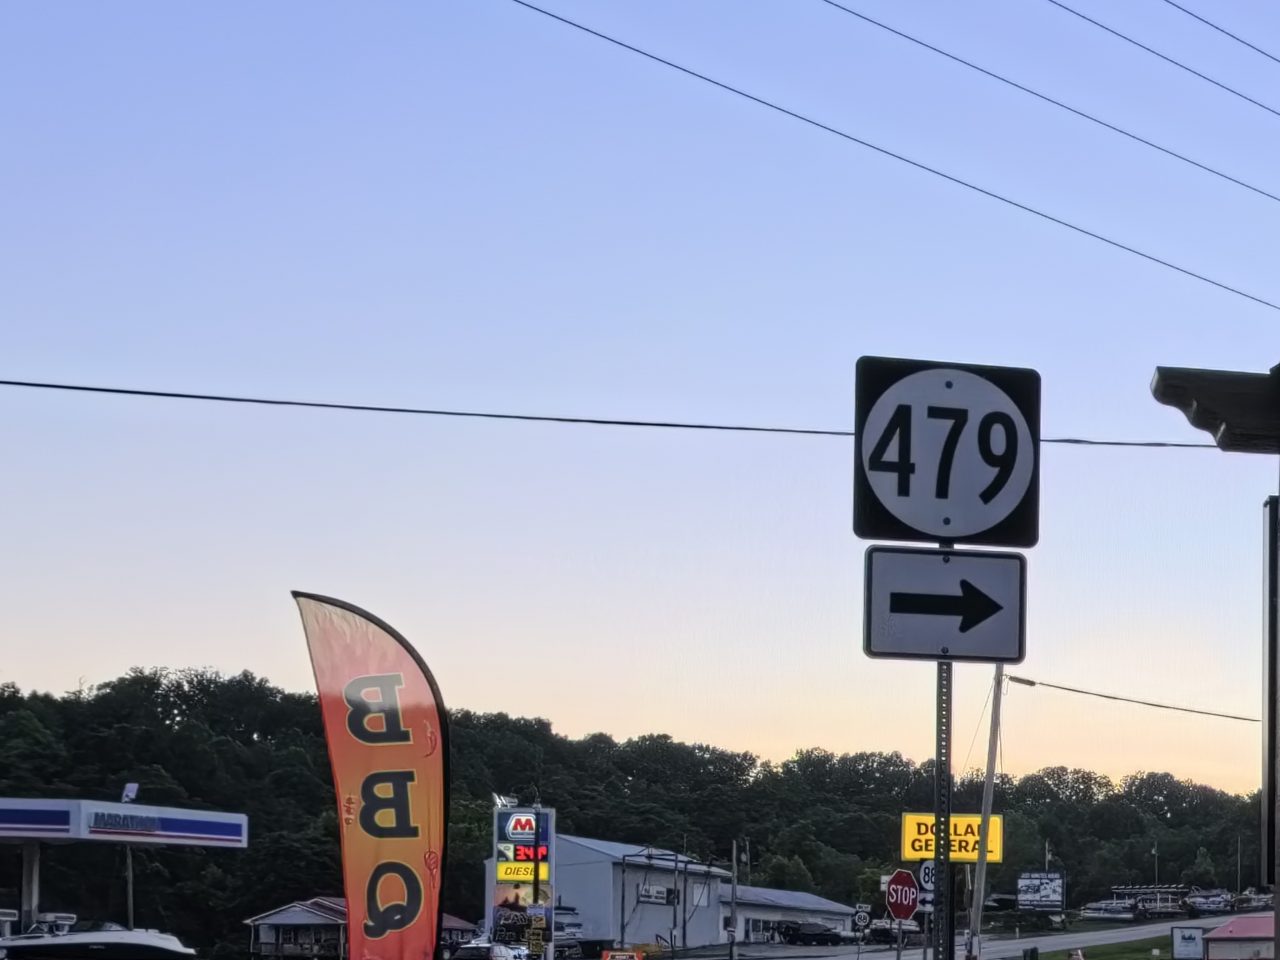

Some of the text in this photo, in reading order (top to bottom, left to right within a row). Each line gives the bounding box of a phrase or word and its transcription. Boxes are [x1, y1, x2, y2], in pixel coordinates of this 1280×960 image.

[868, 404, 1018, 505] 479
[911, 838, 994, 853] GEERA
[889, 884, 917, 906] STOP
